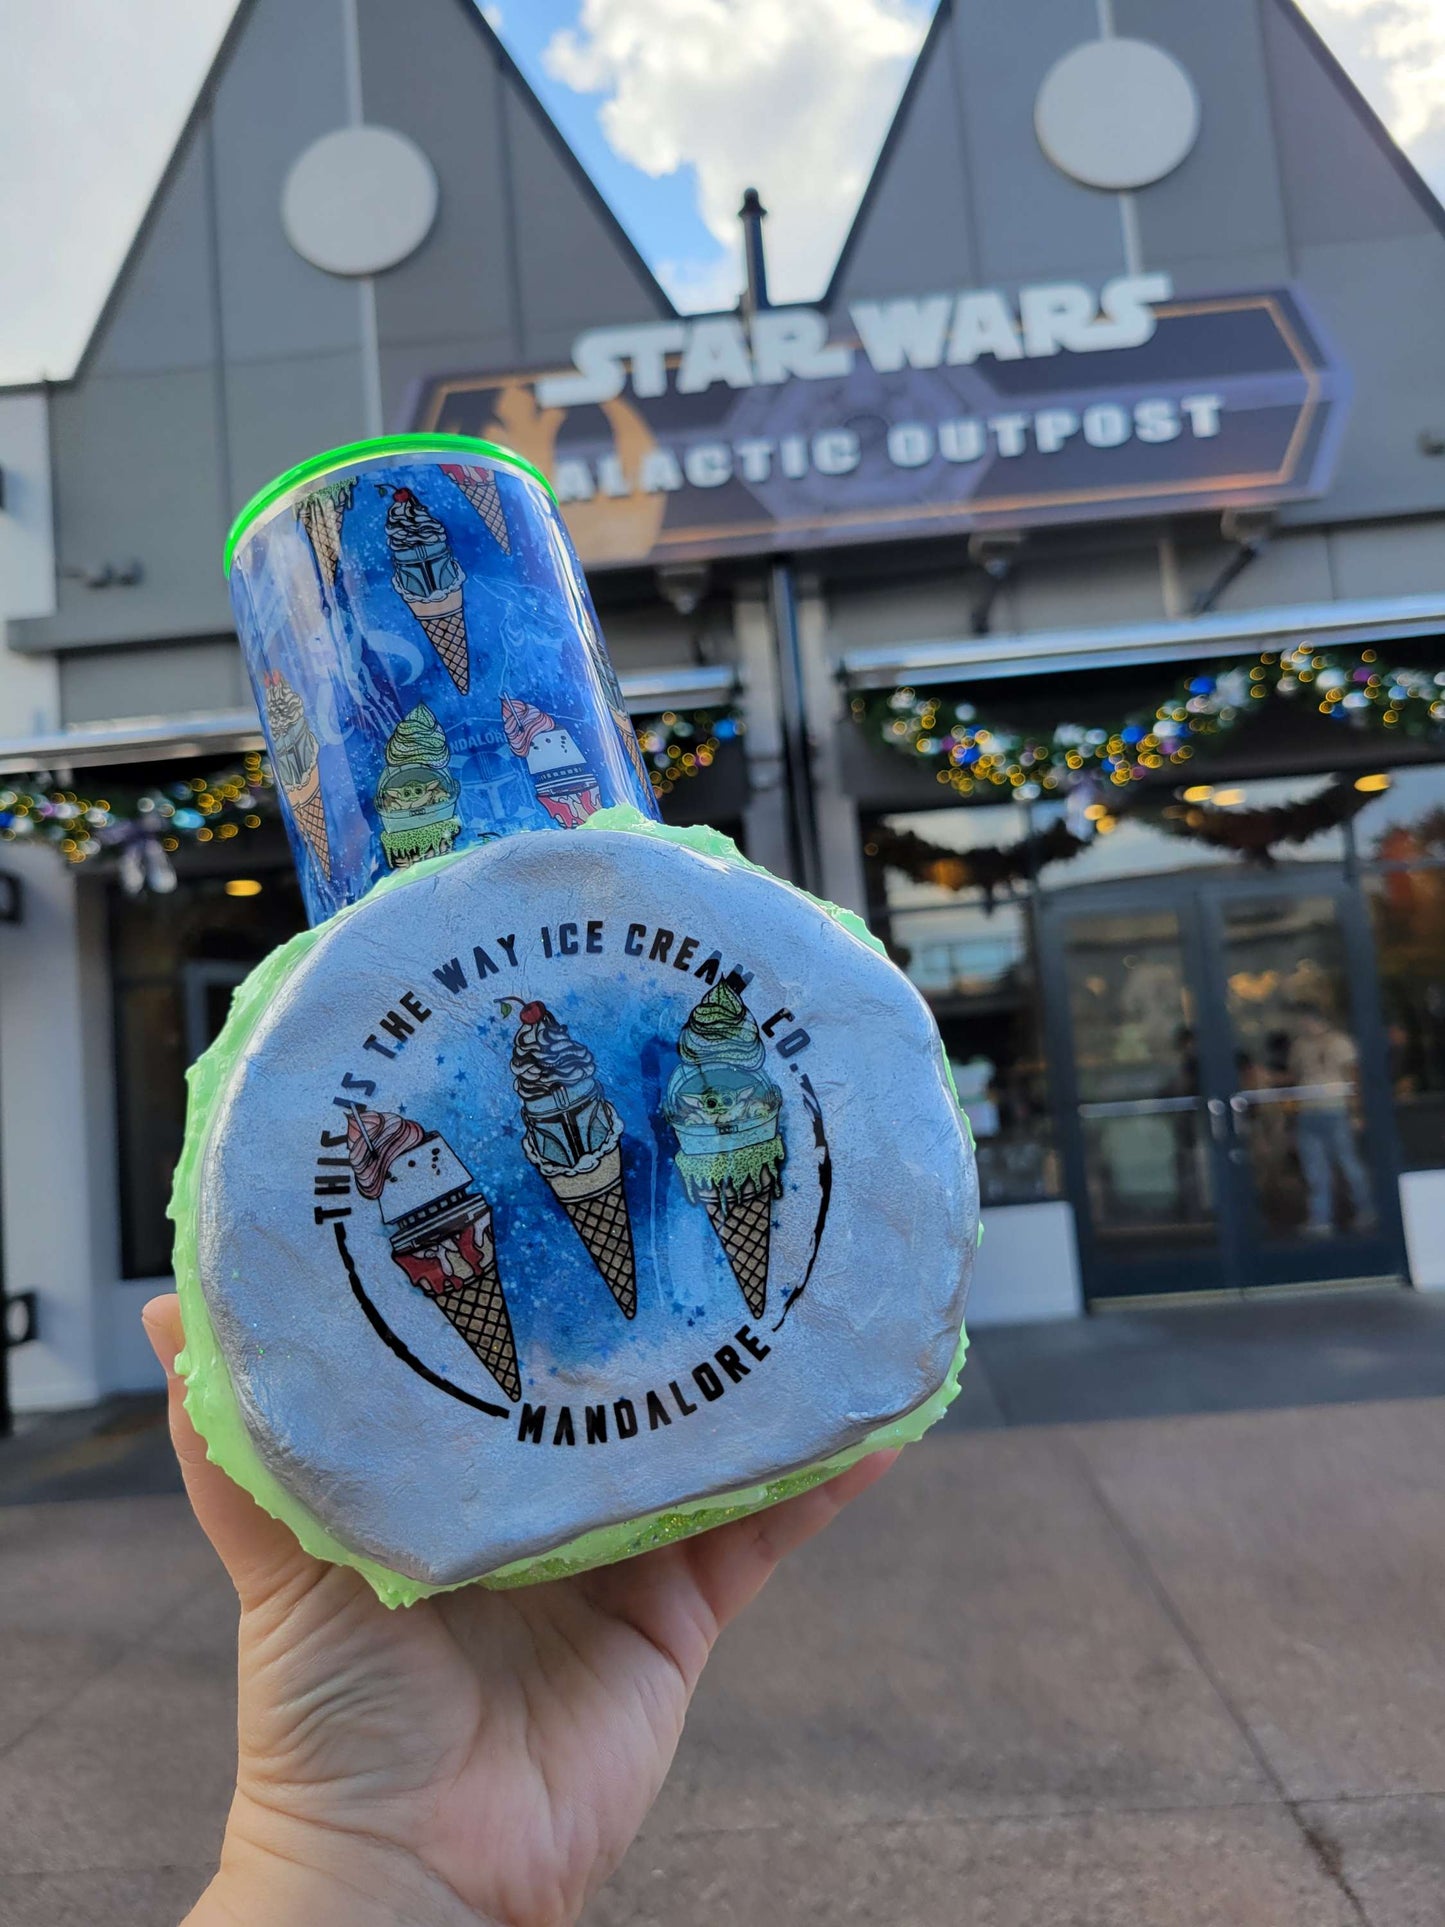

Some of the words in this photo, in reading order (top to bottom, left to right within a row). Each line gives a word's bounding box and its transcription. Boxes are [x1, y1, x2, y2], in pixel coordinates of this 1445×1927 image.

[535, 307, 855, 408] STAR
[848, 272, 1173, 374] WARS
[555, 428, 862, 501] ALACTIC
[887, 393, 1223, 468] OUTPOST
[448, 731, 508, 754] NDALOR
[333, 1072, 377, 1113] IS
[362, 990, 432, 1060] THE
[432, 934, 518, 995] WAY
[541, 920, 604, 958] ICE
[624, 922, 755, 996] CREAM
[517, 1324, 772, 1446] MANDALORE
